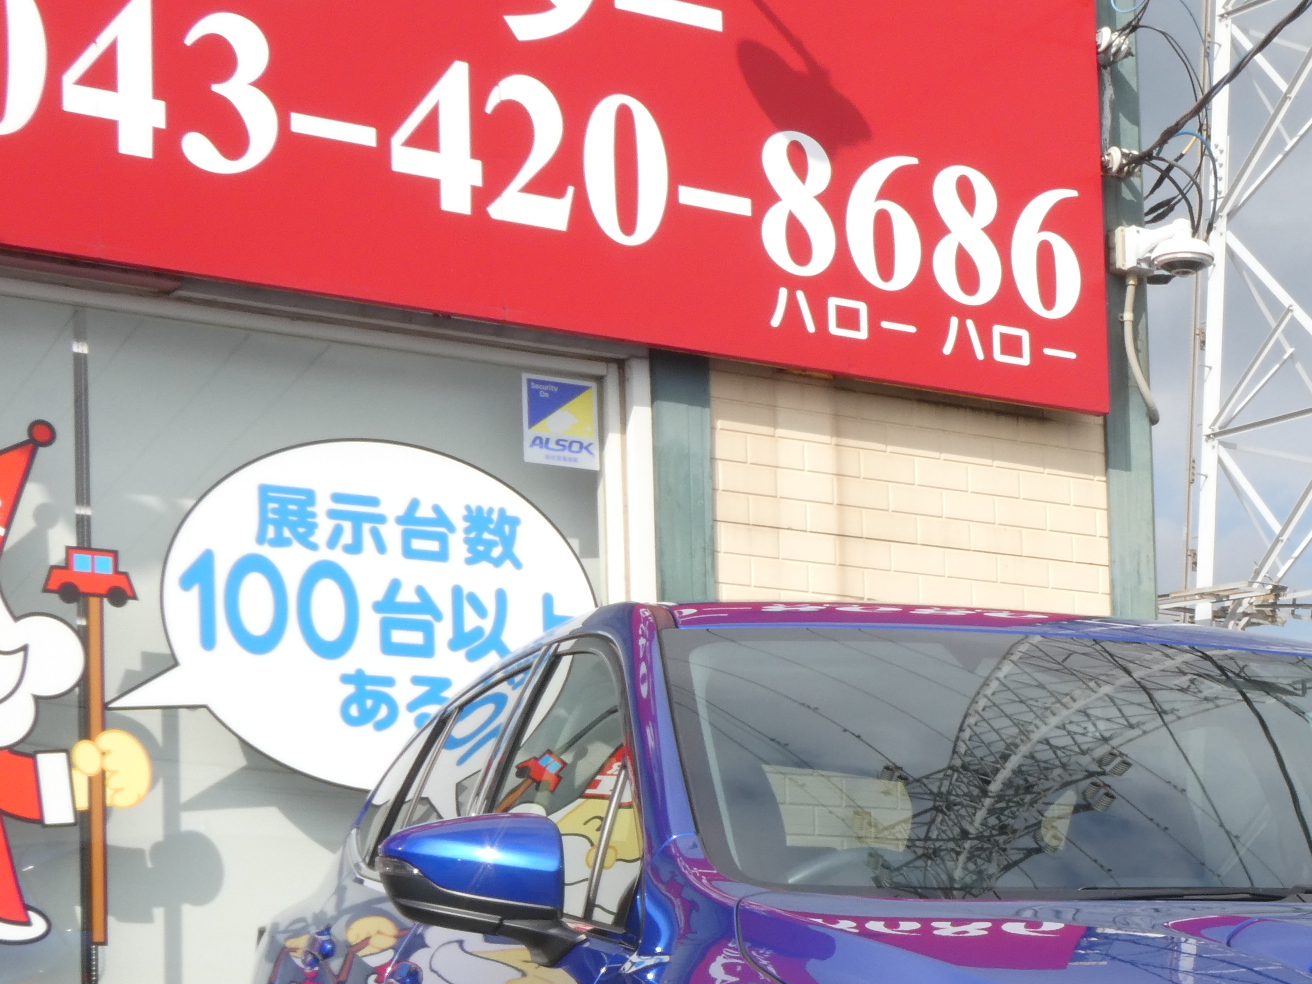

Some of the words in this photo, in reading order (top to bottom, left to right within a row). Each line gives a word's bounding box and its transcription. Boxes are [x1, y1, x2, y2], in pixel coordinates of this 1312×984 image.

[770, 287, 917, 340] ハロー
[943, 315, 1077, 366] ハロー
[531, 381, 558, 392] Security
[540, 390, 549, 398] On
[529, 436, 595, 456] ALSOK
[256, 483, 523, 570] 展示台数
